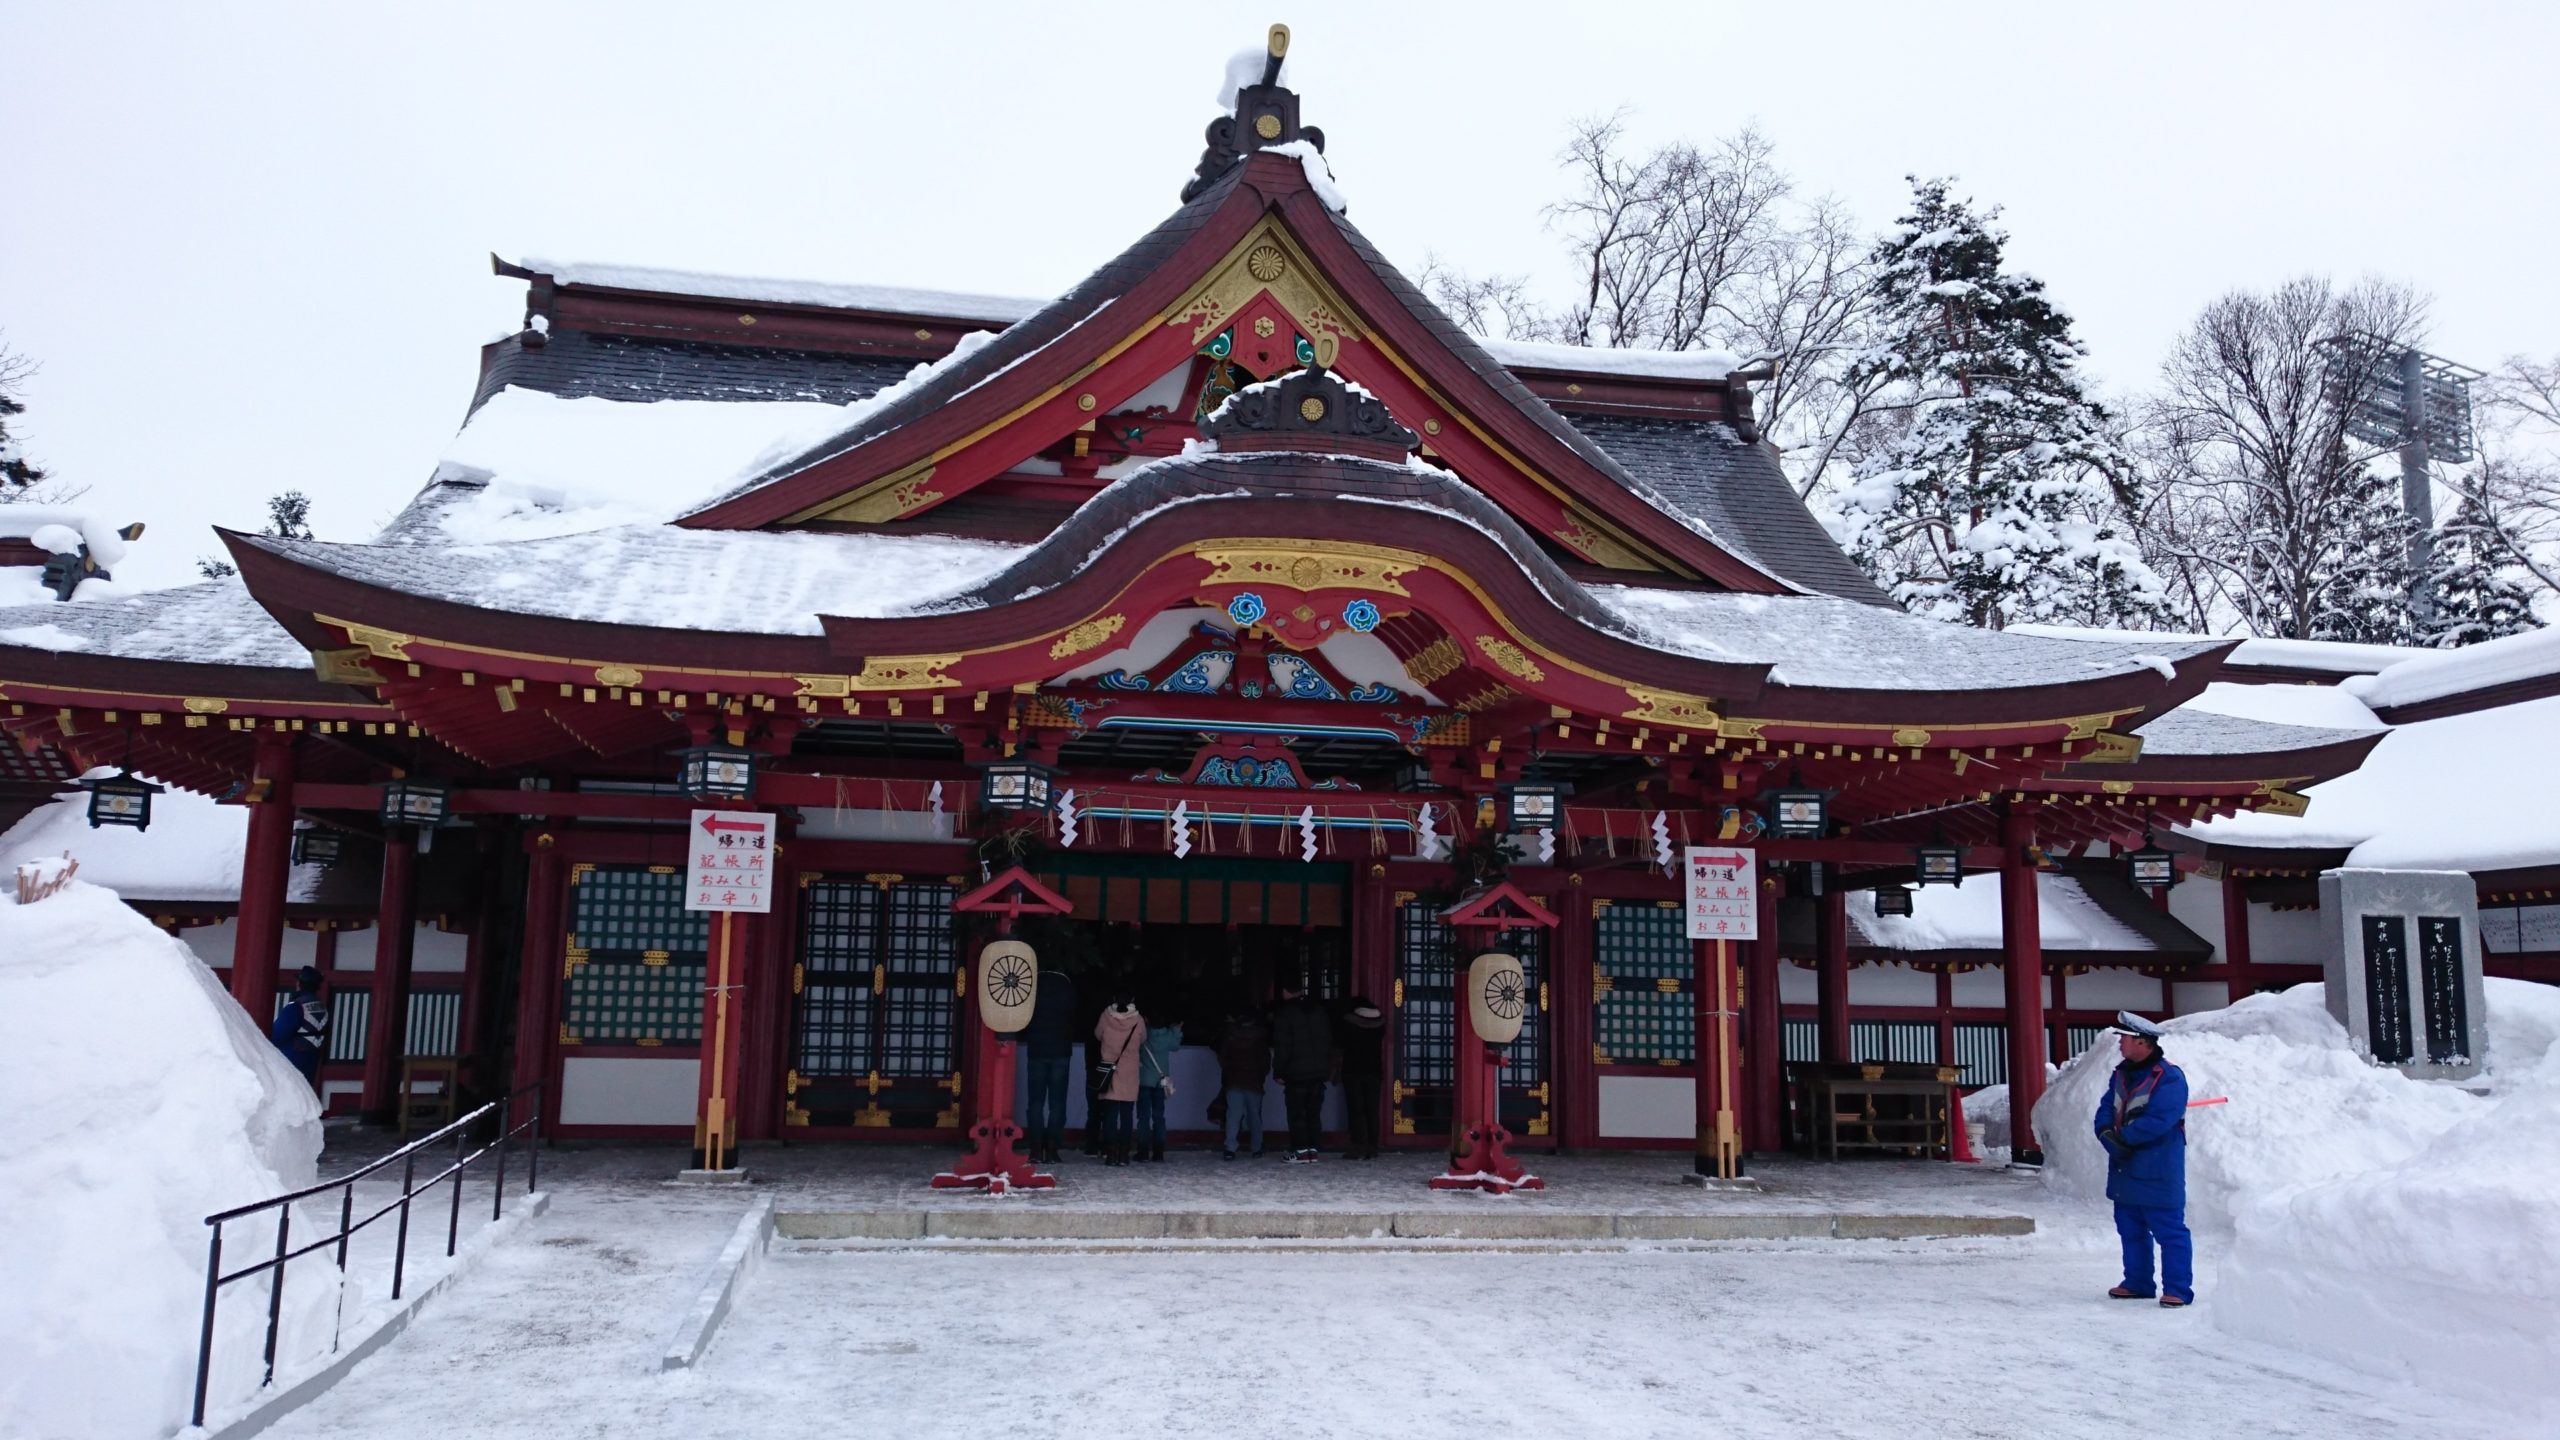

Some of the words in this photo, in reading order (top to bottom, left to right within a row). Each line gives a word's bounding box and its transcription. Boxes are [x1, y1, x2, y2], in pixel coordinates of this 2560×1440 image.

[718, 834, 766, 849] 帰り道
[701, 854, 765, 871] 記帳所
[701, 874, 764, 887] おみくじ
[1694, 867, 1736, 881] 帰り道
[700, 890, 758, 905] お守り
[1695, 885, 1749, 900] 記帳所
[1696, 903, 1749, 917] おみくじ
[1696, 920, 1746, 934] お守り
